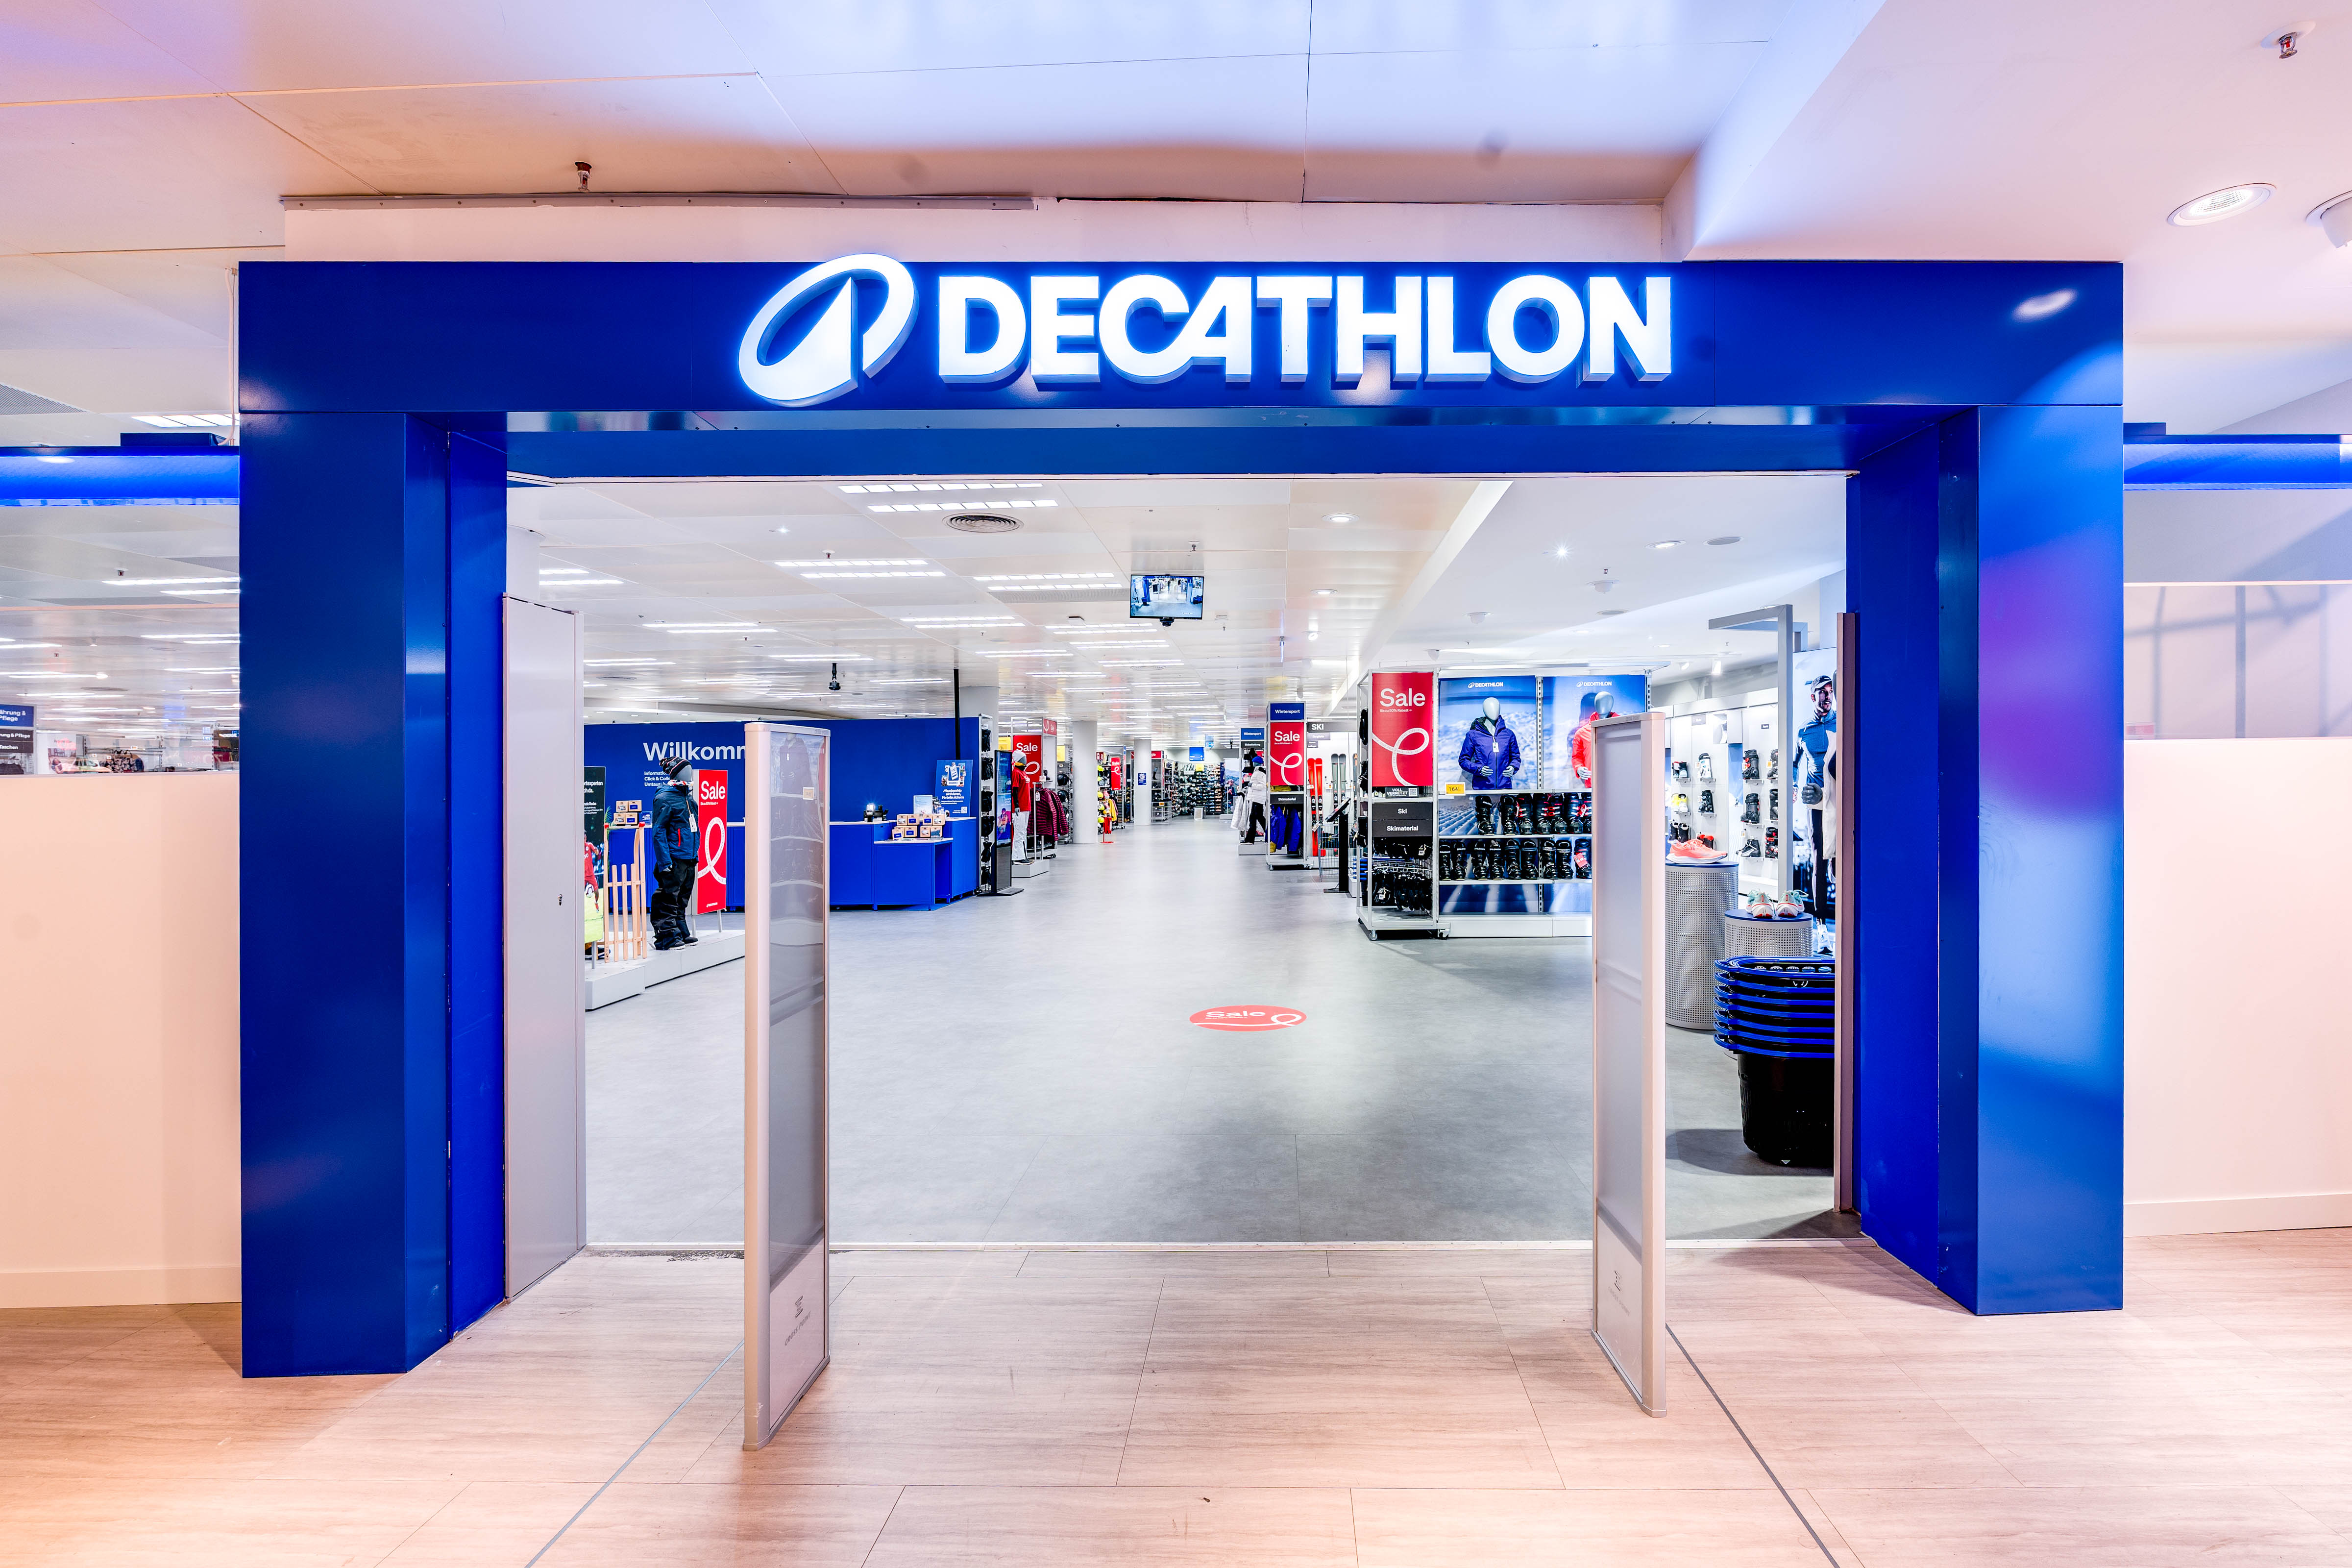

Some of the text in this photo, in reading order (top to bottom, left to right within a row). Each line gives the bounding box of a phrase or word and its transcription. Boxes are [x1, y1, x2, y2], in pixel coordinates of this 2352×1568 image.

[936, 273, 1673, 384] DECATHLON
[1380, 687, 1426, 707] Sale
[1274, 730, 1300, 742] Sale
[1016, 742, 1038, 752] Sale
[700, 780, 726, 800] Sale
